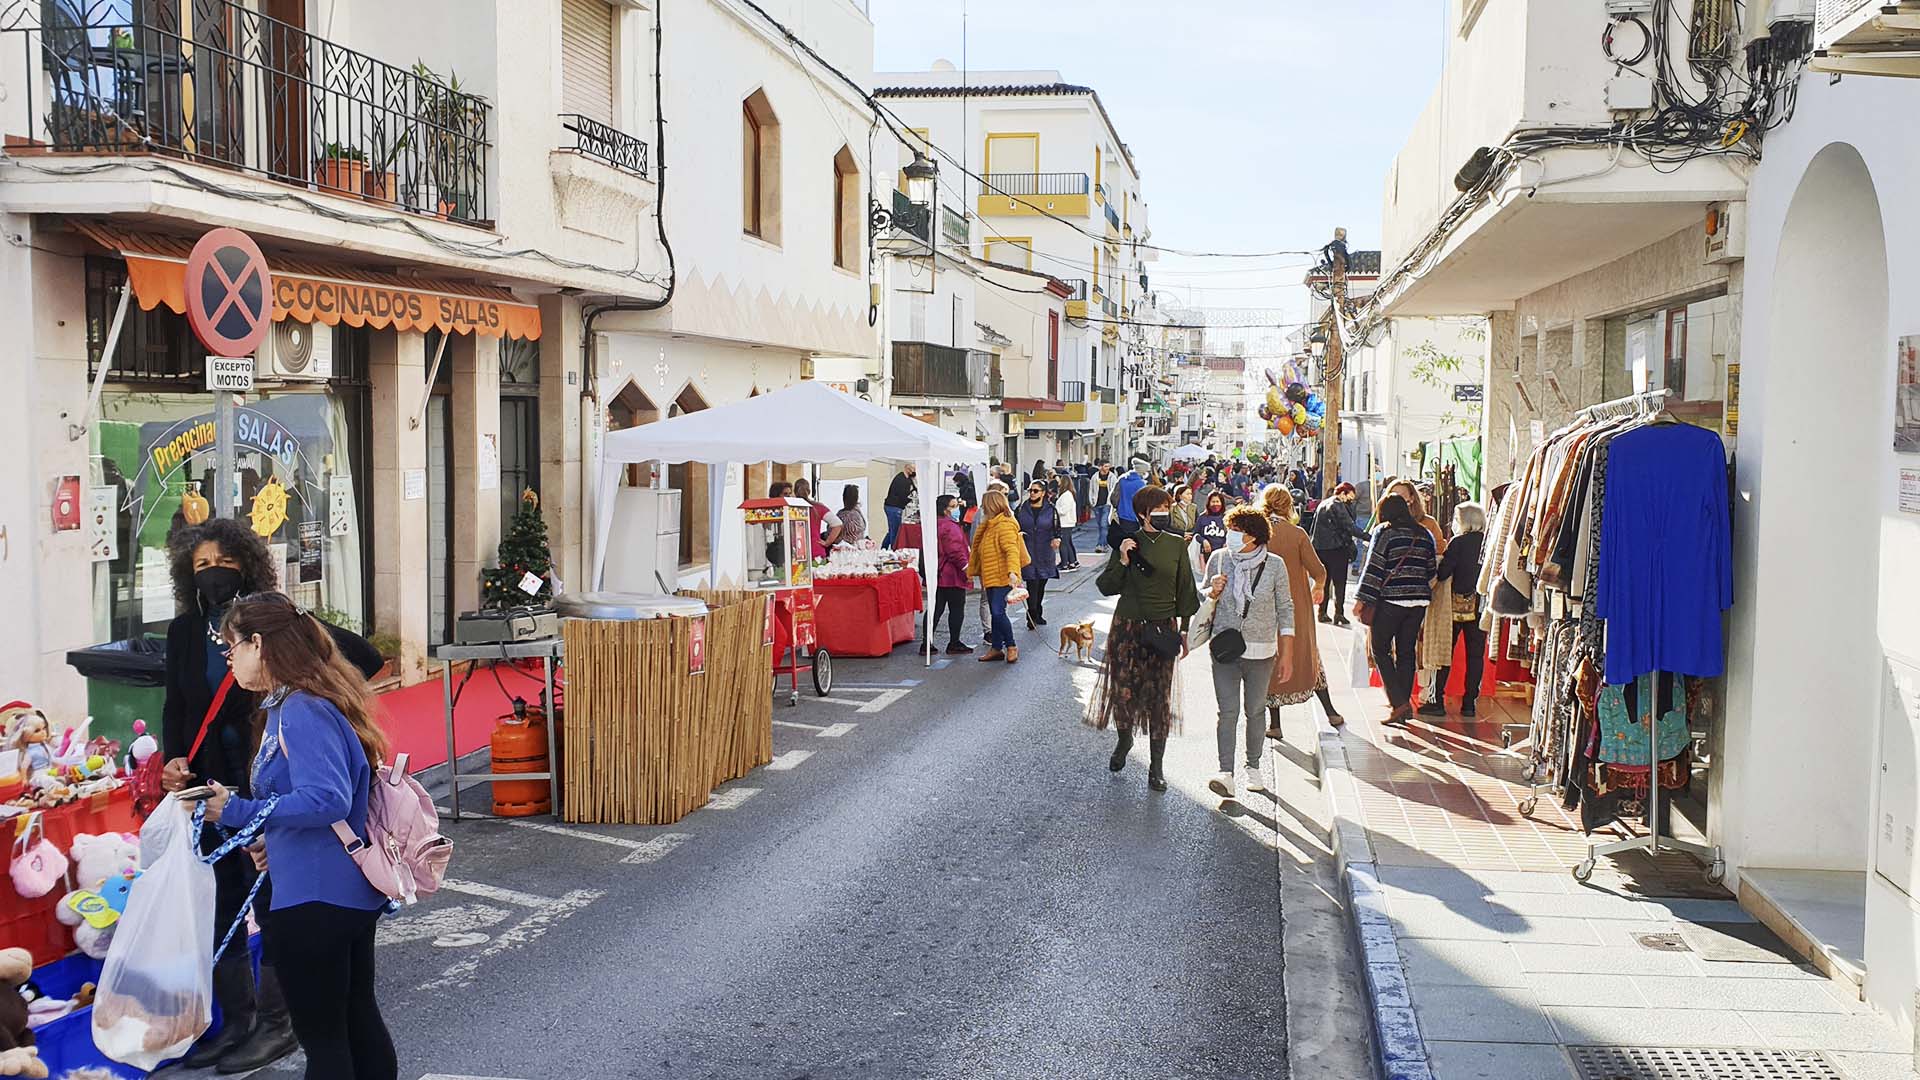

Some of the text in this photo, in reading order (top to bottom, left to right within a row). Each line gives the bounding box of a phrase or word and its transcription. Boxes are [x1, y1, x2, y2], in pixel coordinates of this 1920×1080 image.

[272, 279, 499, 328] COCINADOS SALAS
[214, 362, 251, 372] EXCEPTO
[216, 374, 249, 387] MOTOS
[153, 413, 294, 475] Precocina SALAS
[236, 458, 255, 469] AWAY
